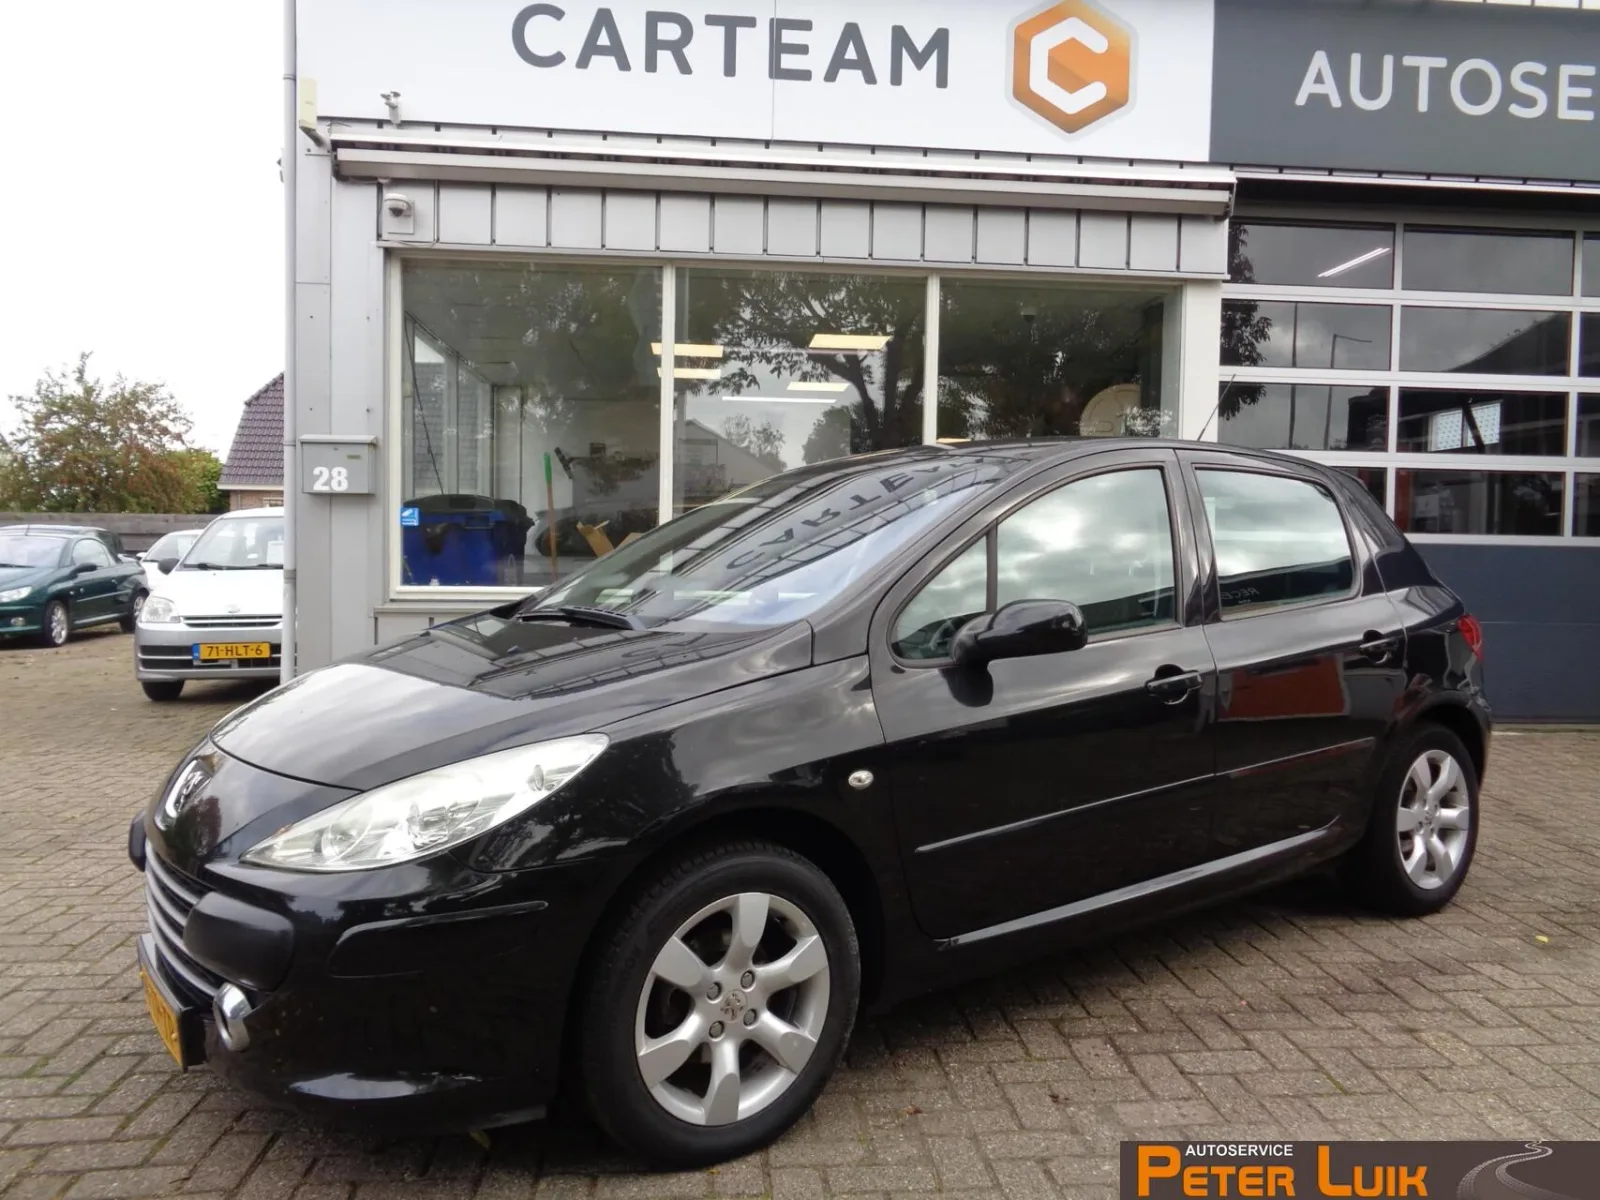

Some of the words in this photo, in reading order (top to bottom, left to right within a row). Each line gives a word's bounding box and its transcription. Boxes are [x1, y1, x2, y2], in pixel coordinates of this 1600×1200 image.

[512, 3, 950, 89] CARTEAM
[1295, 50, 1597, 121] AUTOSE
[313, 466, 349, 492] 28
[206, 644, 264, 657] 71-HLT-6
